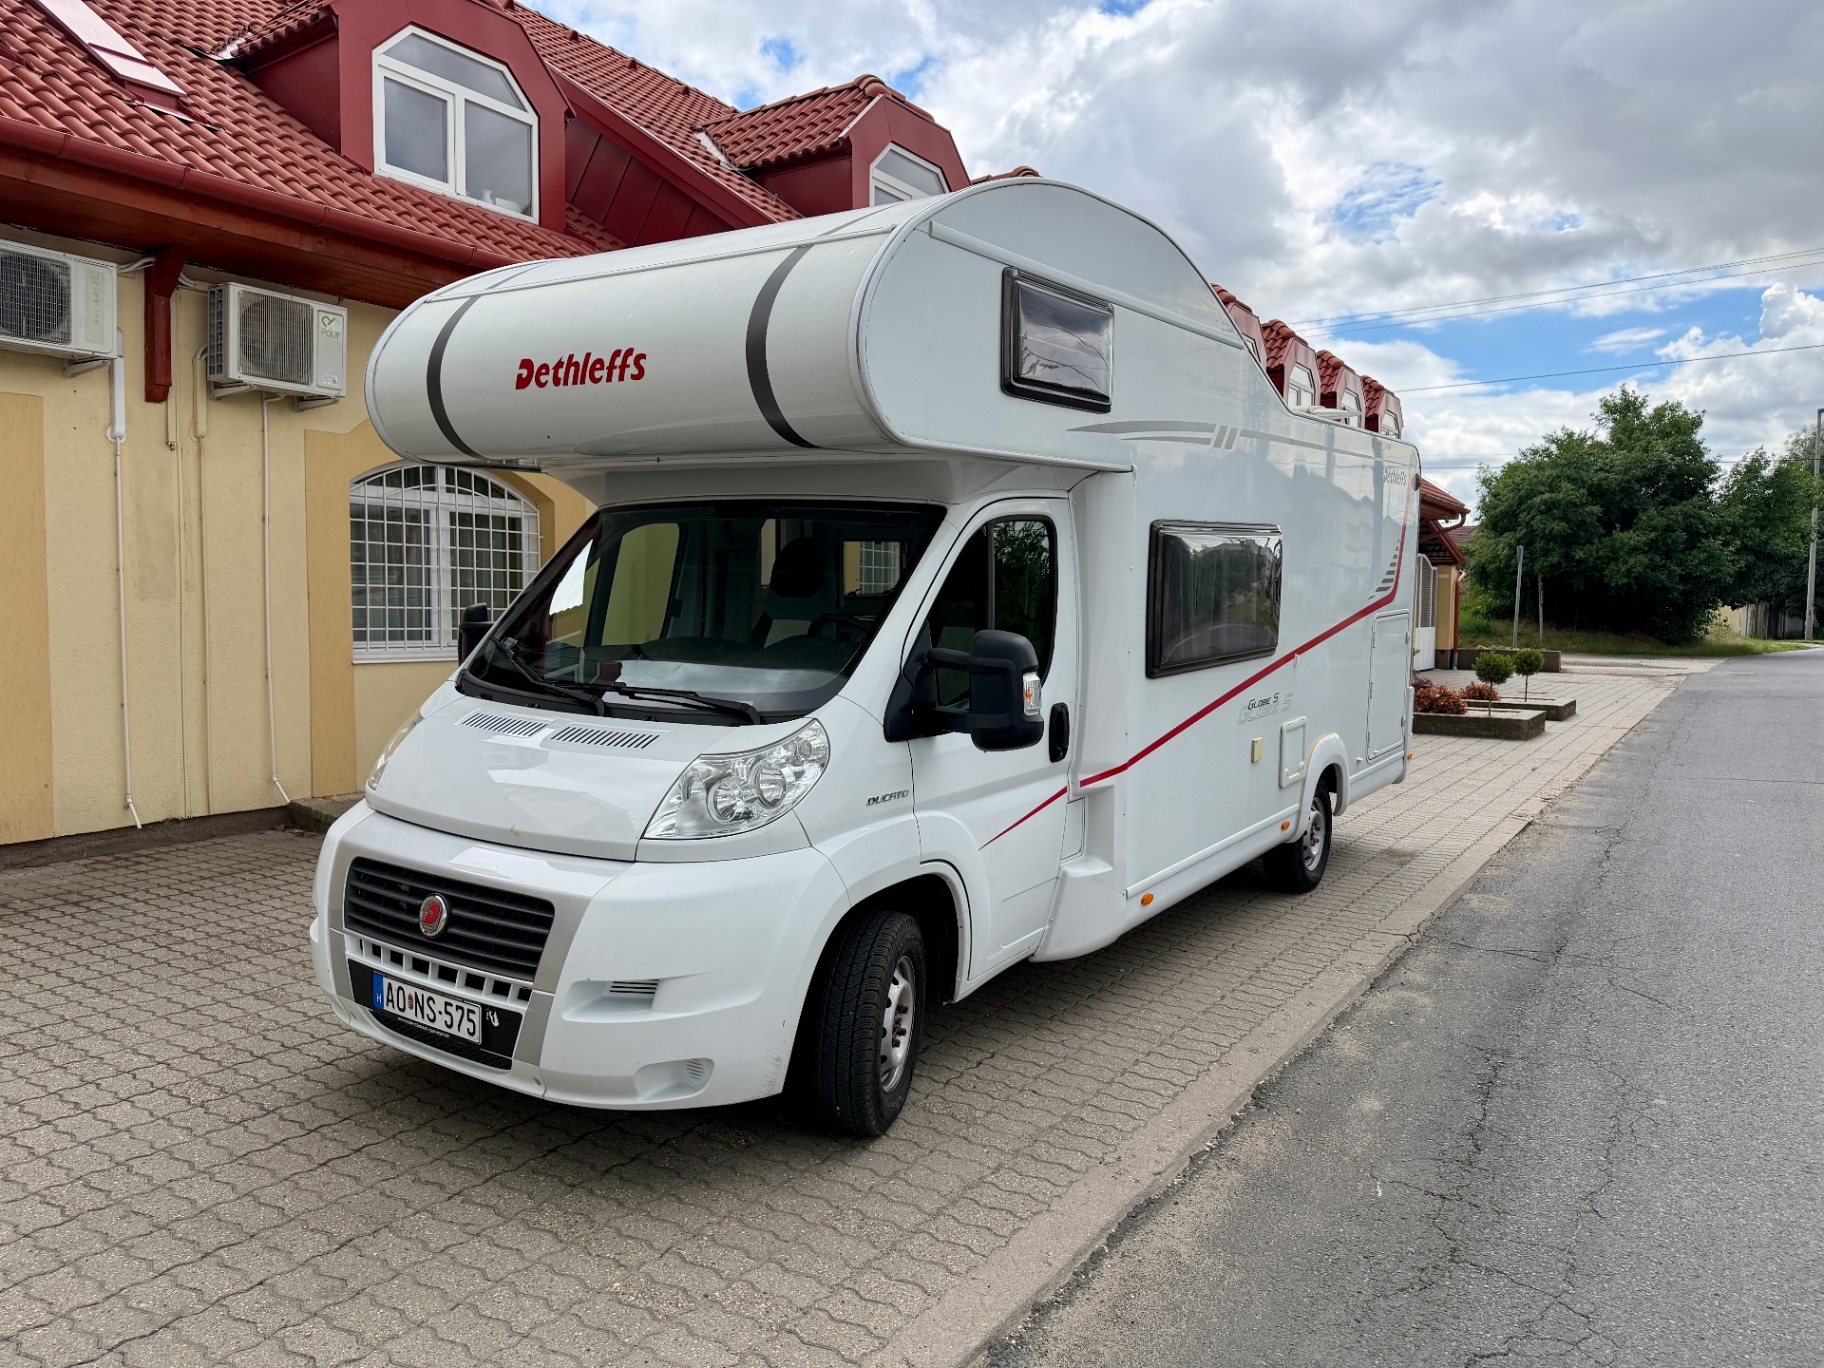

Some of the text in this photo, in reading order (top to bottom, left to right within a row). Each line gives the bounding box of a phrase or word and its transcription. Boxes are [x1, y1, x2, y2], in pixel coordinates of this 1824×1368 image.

[515, 347, 647, 390] Dethleffs
[866, 789, 909, 806] DUCATO
[376, 992, 382, 1004] H
